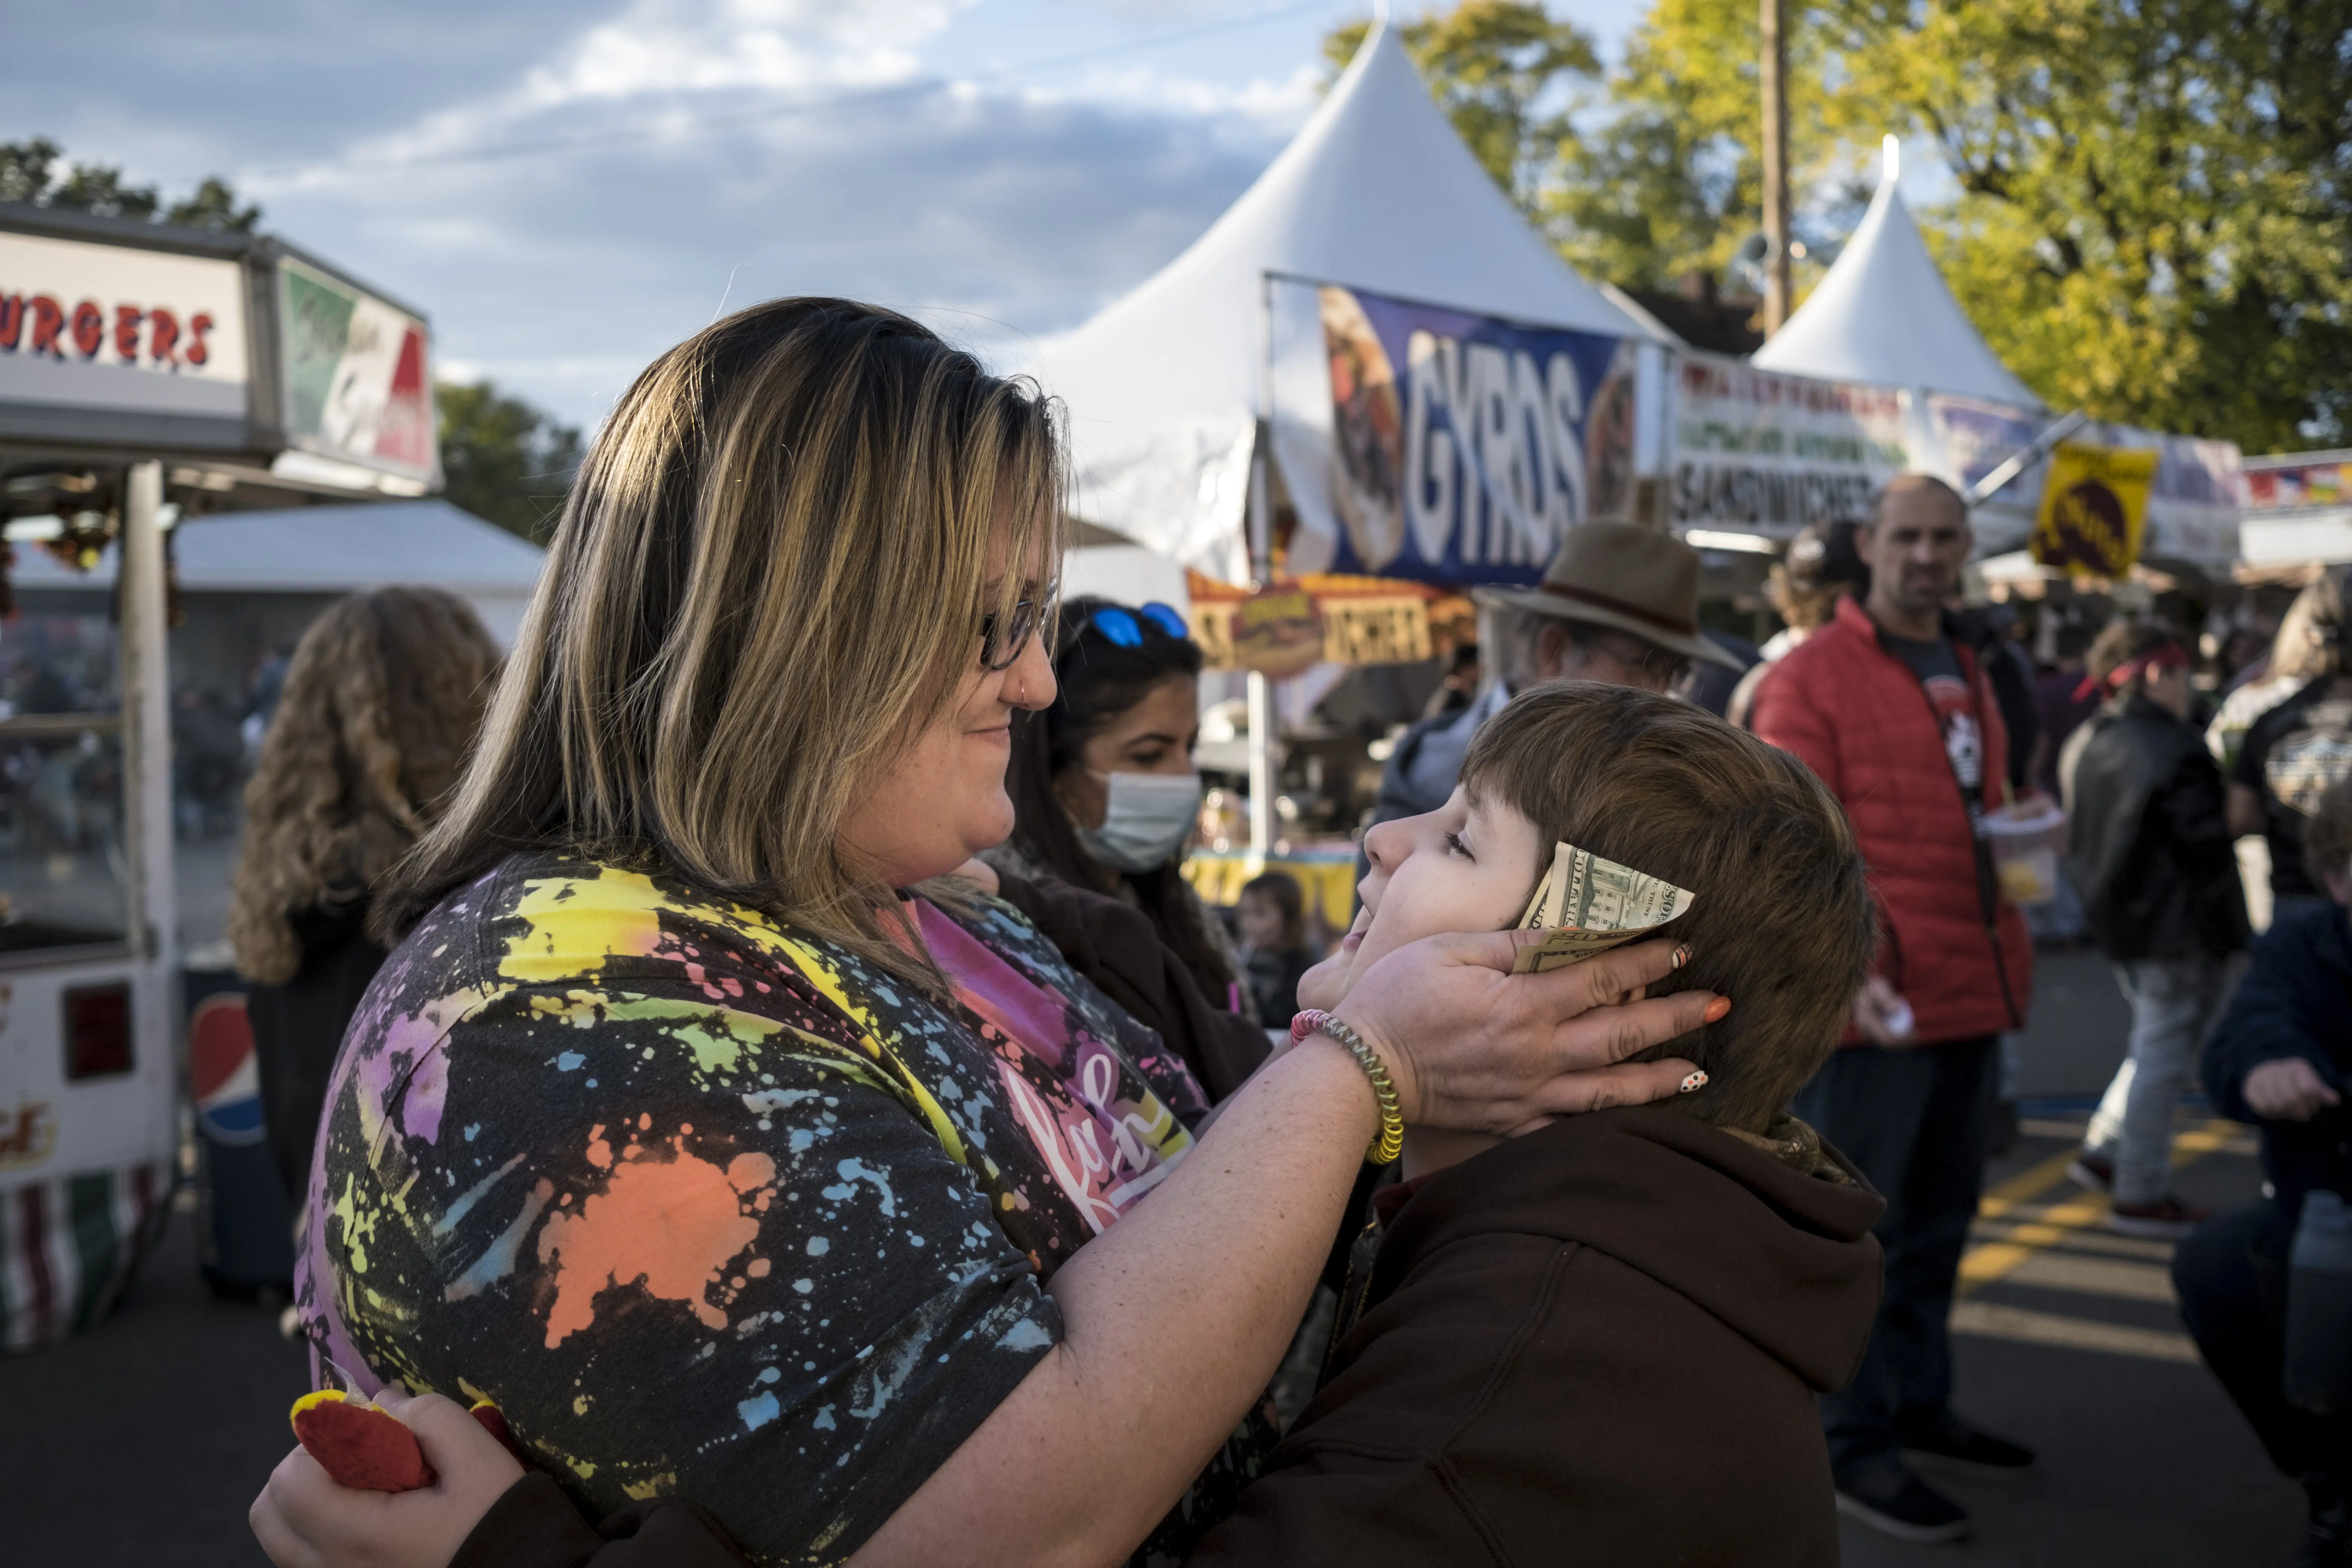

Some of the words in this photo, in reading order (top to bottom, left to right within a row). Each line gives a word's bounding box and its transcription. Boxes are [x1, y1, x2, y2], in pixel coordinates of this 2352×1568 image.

[1406, 329, 1587, 569] GYROS
[1564, 848, 1586, 927] DOLLARS
[1644, 891, 1655, 917] TRUST
[1658, 901, 1672, 922] OF
[1551, 932, 1598, 941] 20
